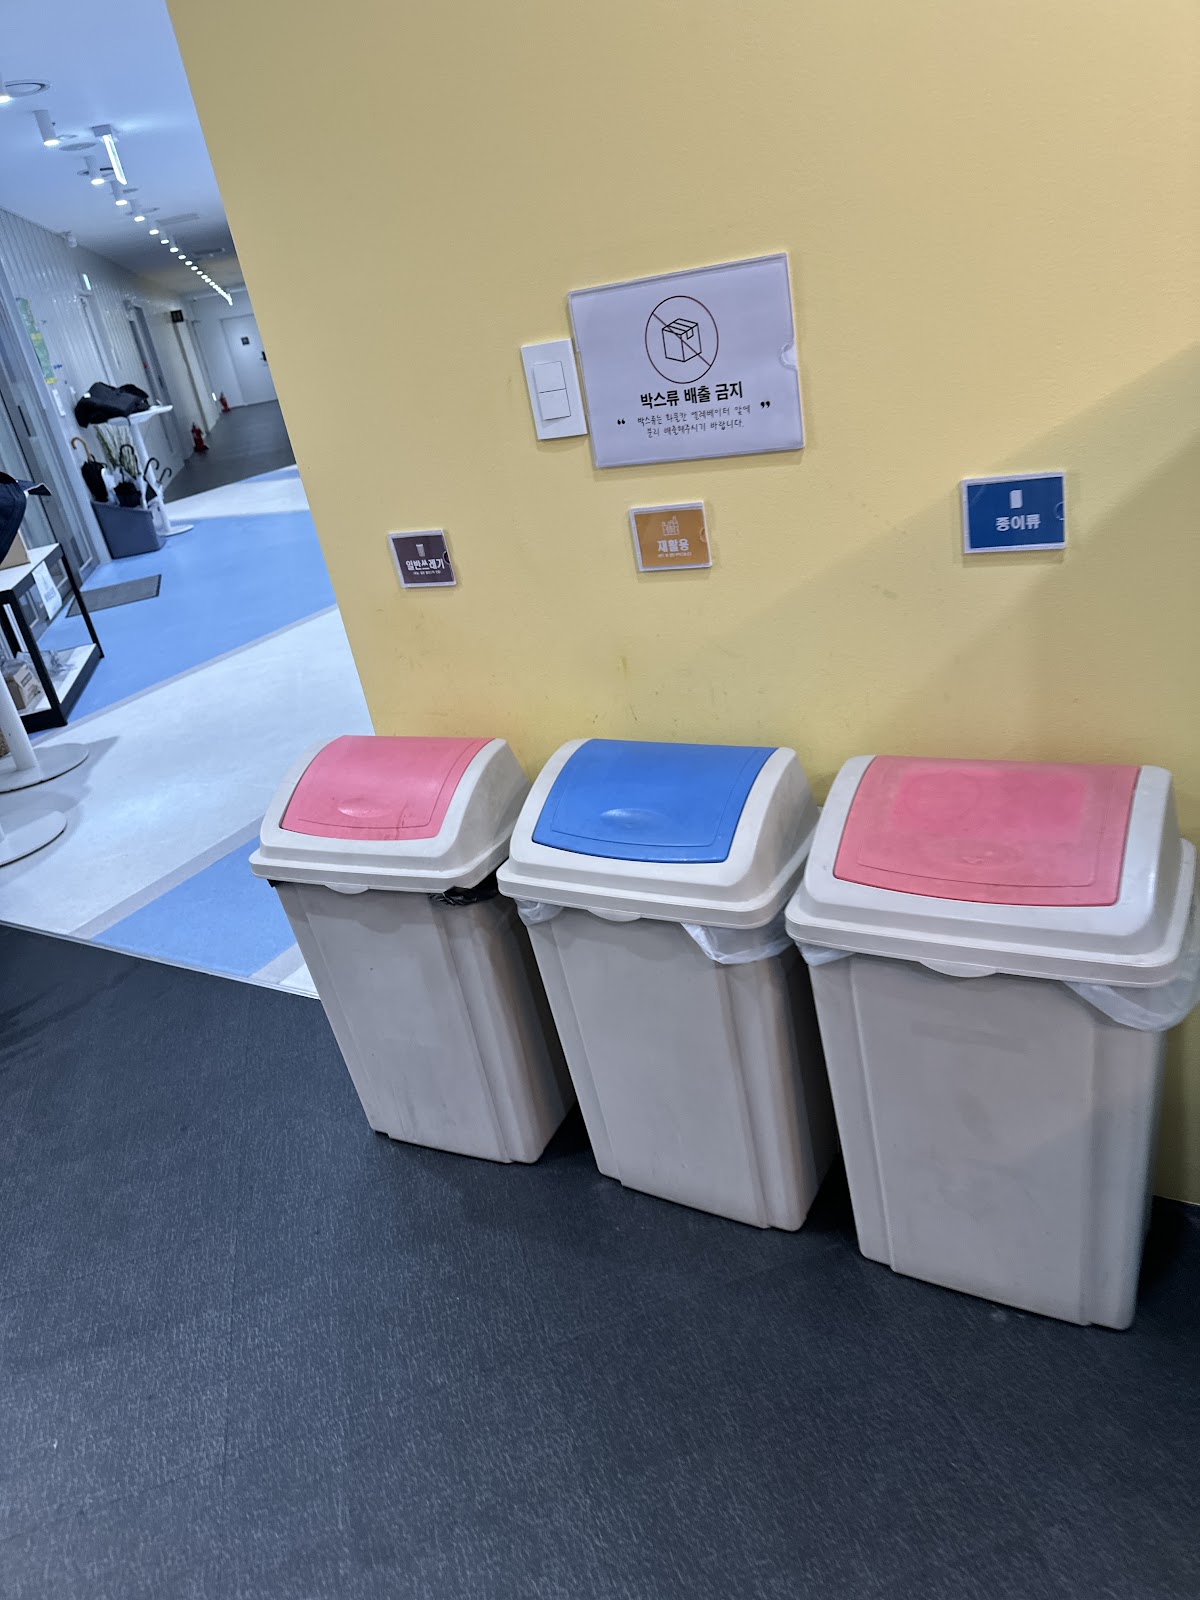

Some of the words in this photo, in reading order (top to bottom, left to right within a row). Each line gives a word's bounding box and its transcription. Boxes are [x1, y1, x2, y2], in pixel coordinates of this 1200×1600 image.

[640, 390, 680, 409] 박스류
[684, 385, 711, 404] 배출
[715, 381, 743, 401] 금지
[637, 415, 663, 427] 박스류는
[734, 404, 751, 415] 앞에
[647, 427, 660, 438] 분리
[664, 422, 706, 436] 배출해주시기
[710, 418, 745, 430] 바랍니다.
[995, 514, 1041, 532] 종이류
[657, 538, 689, 552] 재활용
[405, 558, 445, 571] 일반쓰레기
